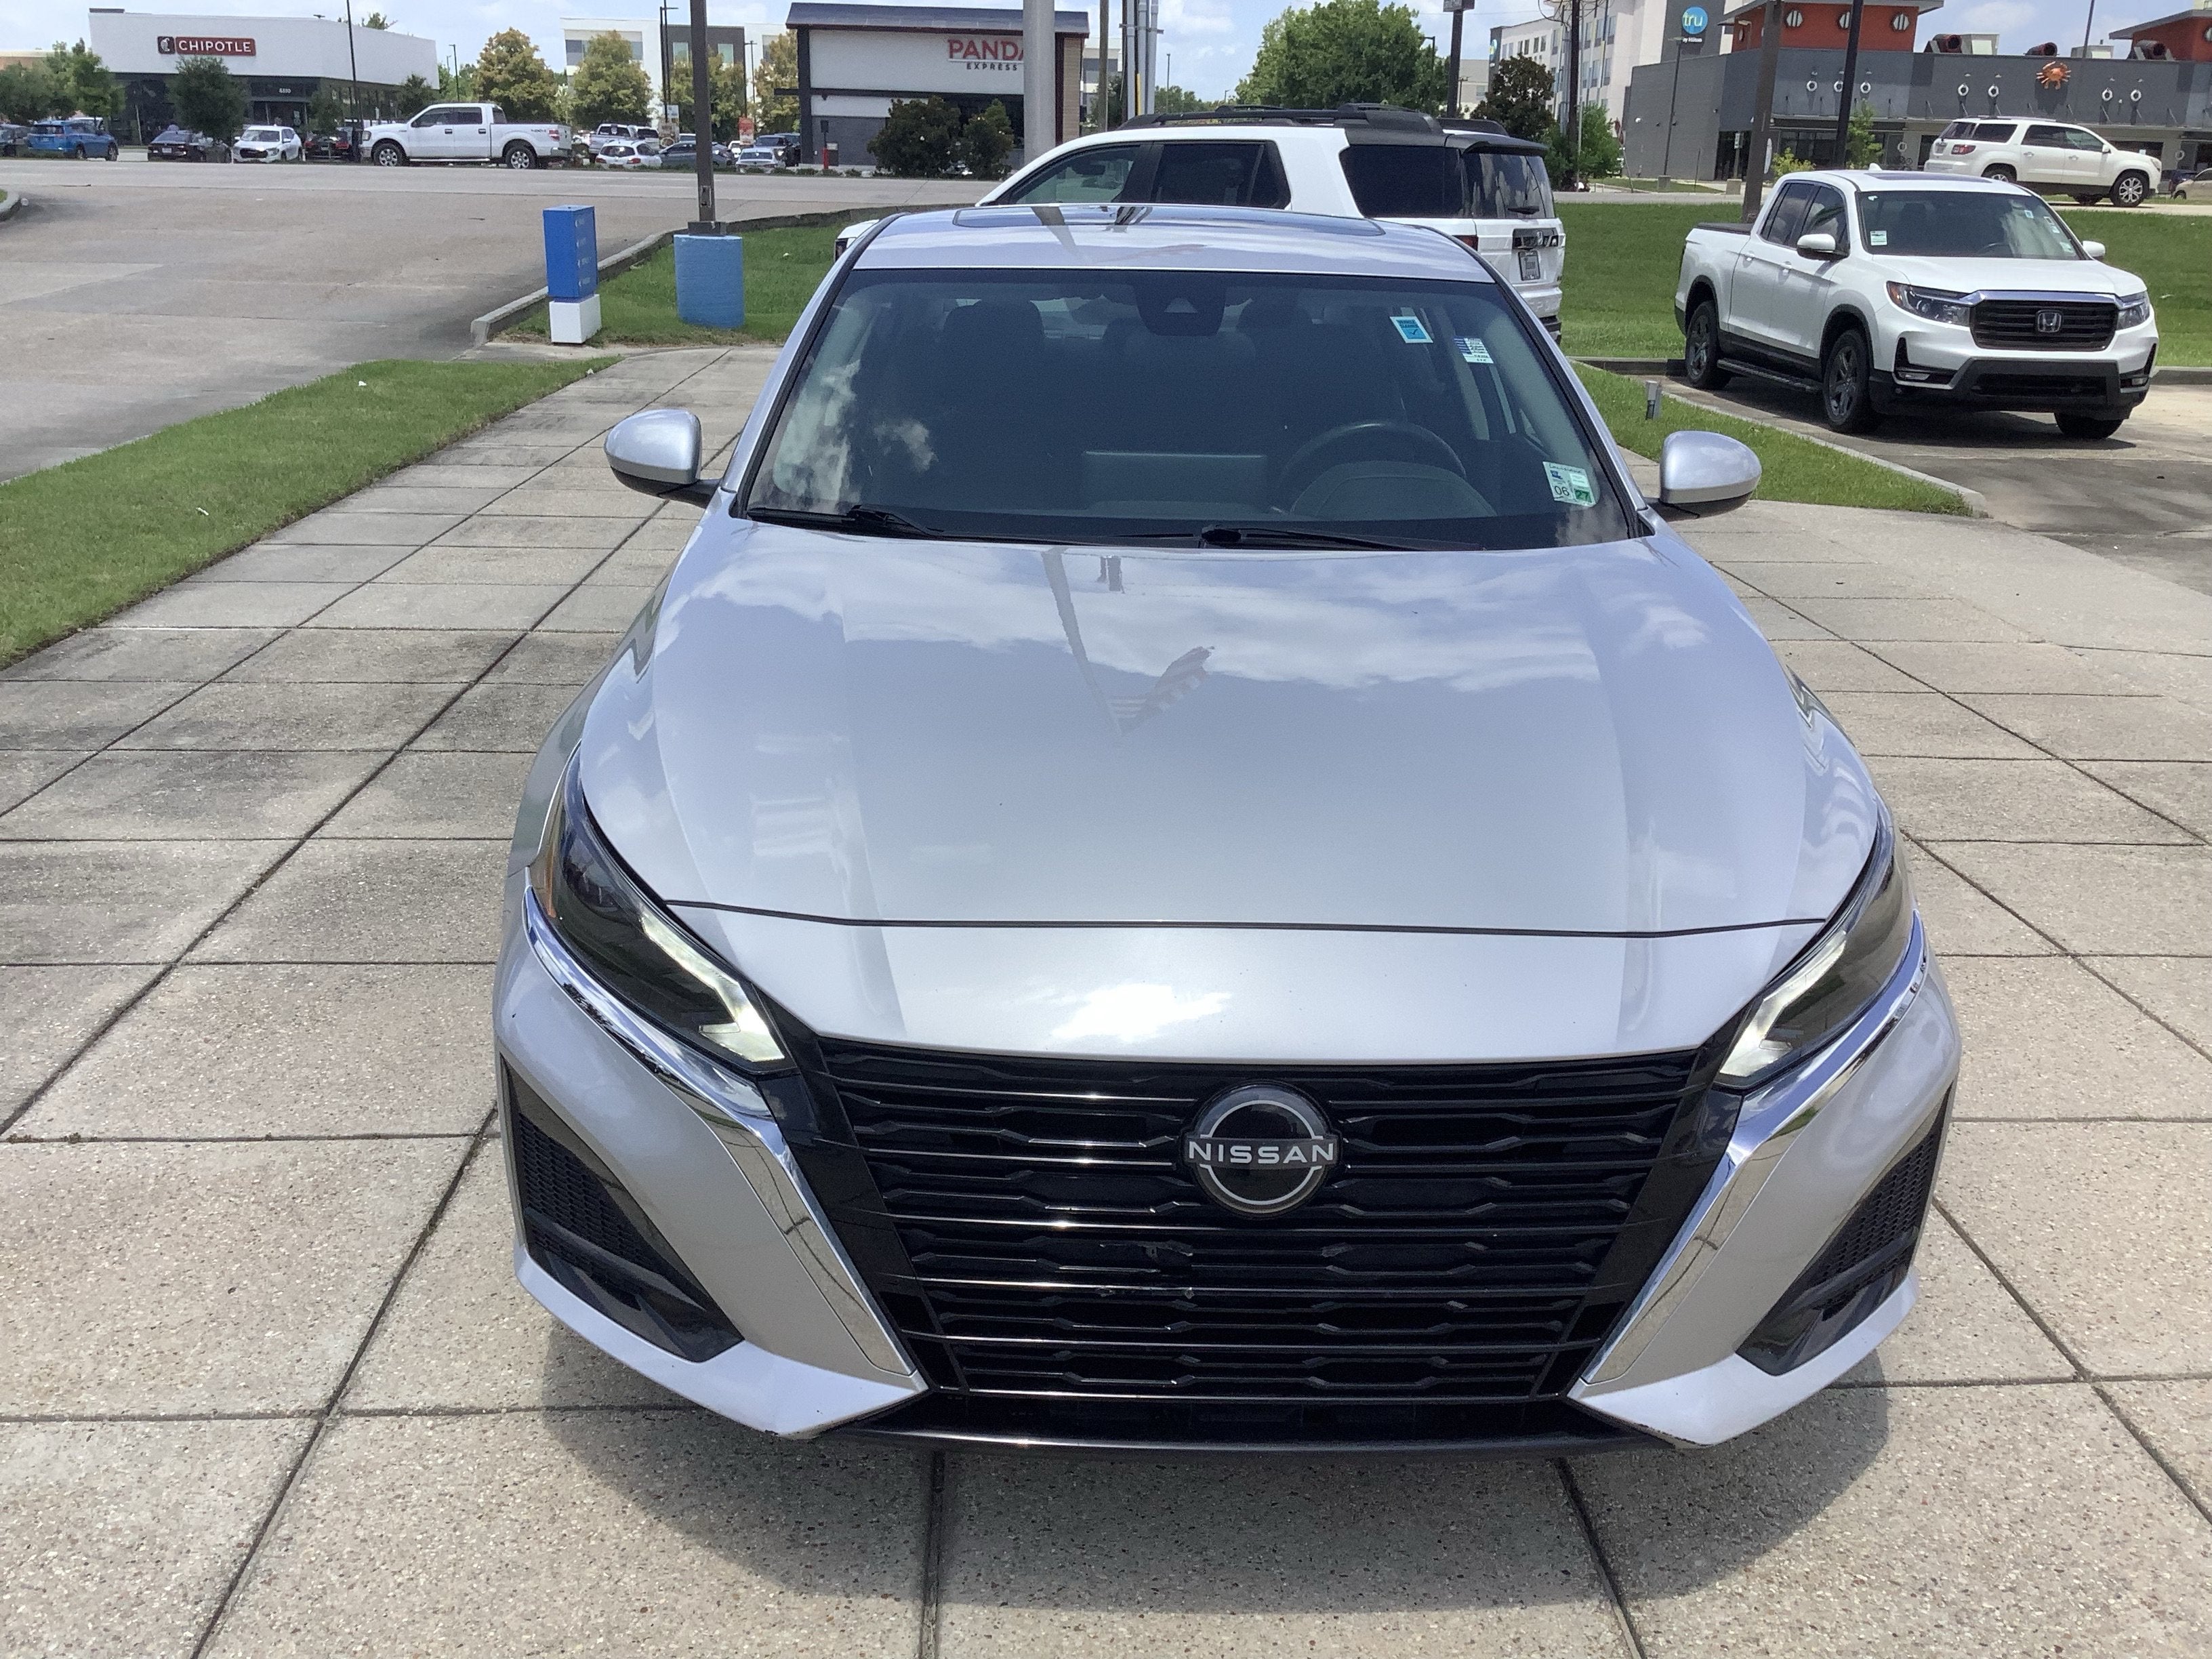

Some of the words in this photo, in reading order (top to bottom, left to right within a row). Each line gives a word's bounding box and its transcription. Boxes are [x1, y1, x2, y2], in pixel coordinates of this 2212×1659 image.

[1682, 12, 1703, 26] tru
[178, 40, 251, 52] CHIPOTLE
[947, 39, 1023, 60] PAND
[966, 62, 1018, 71] EXPRESS
[1554, 485, 1570, 496] 06
[1574, 489, 1590, 501] 27
[1188, 1141, 1334, 1165] NISSAN
